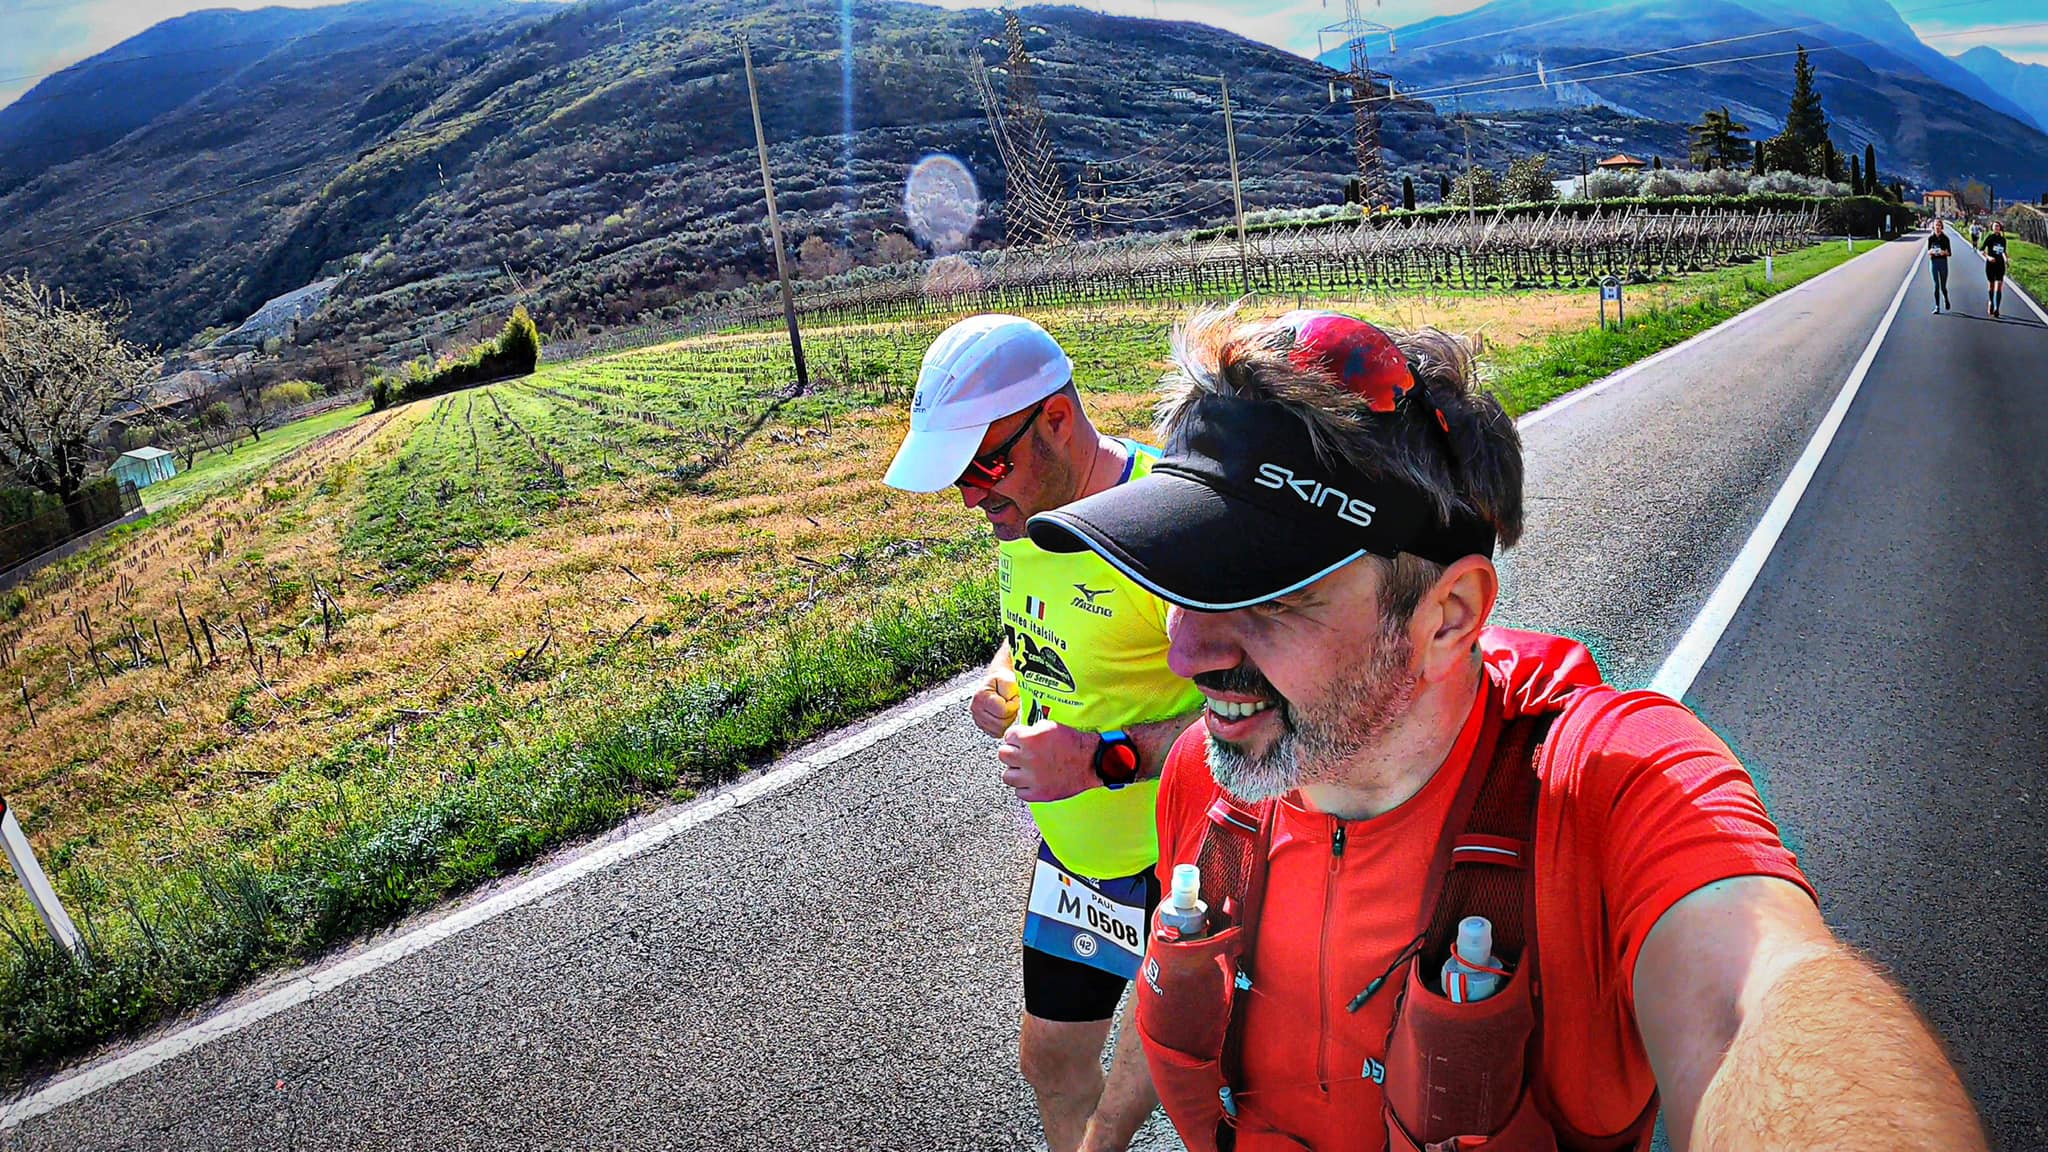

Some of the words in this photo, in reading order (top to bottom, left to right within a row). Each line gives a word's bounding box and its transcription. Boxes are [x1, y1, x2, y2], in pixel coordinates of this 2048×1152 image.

[1254, 462, 1377, 528] SKINS
[1070, 596, 1113, 618] MIZUNO
[1006, 609, 1027, 628] trofeo
[1030, 621, 1067, 651] italsilva
[1057, 889, 1081, 920] M
[1086, 904, 1139, 948] 0508
[1091, 893, 1116, 913] PAUL
[1078, 938, 1092, 951] 42
